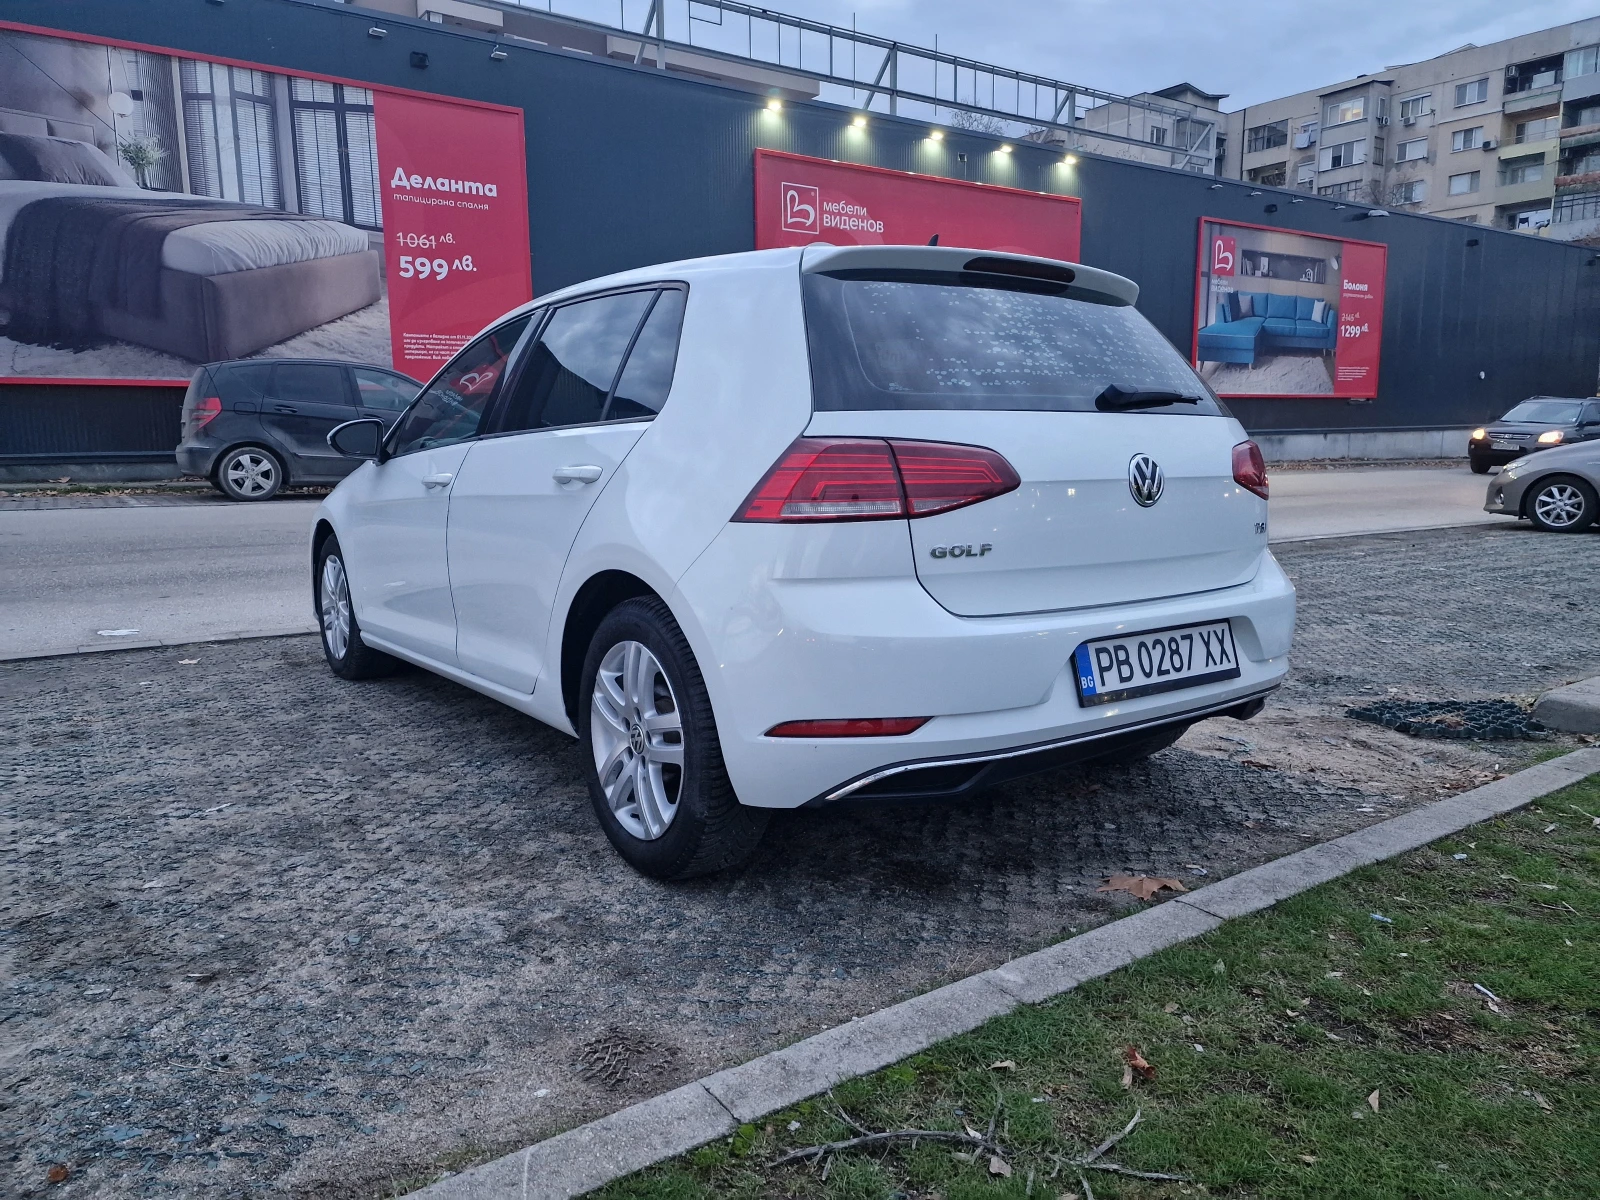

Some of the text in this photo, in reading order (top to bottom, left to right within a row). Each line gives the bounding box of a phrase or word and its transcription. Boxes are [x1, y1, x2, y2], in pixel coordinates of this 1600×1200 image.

[391, 167, 497, 197] Деланта
[393, 193, 489, 210] тапицирана спалня
[823, 201, 867, 216] мебели
[396, 232, 456, 249] 1061 лв.
[399, 255, 477, 281] 599 лв.
[1343, 279, 1369, 291] Болоня
[1340, 324, 1361, 338] 1299
[930, 543, 993, 559] GOLF
[1094, 628, 1232, 686] PB 0287 XX
[1081, 676, 1094, 689] BG
